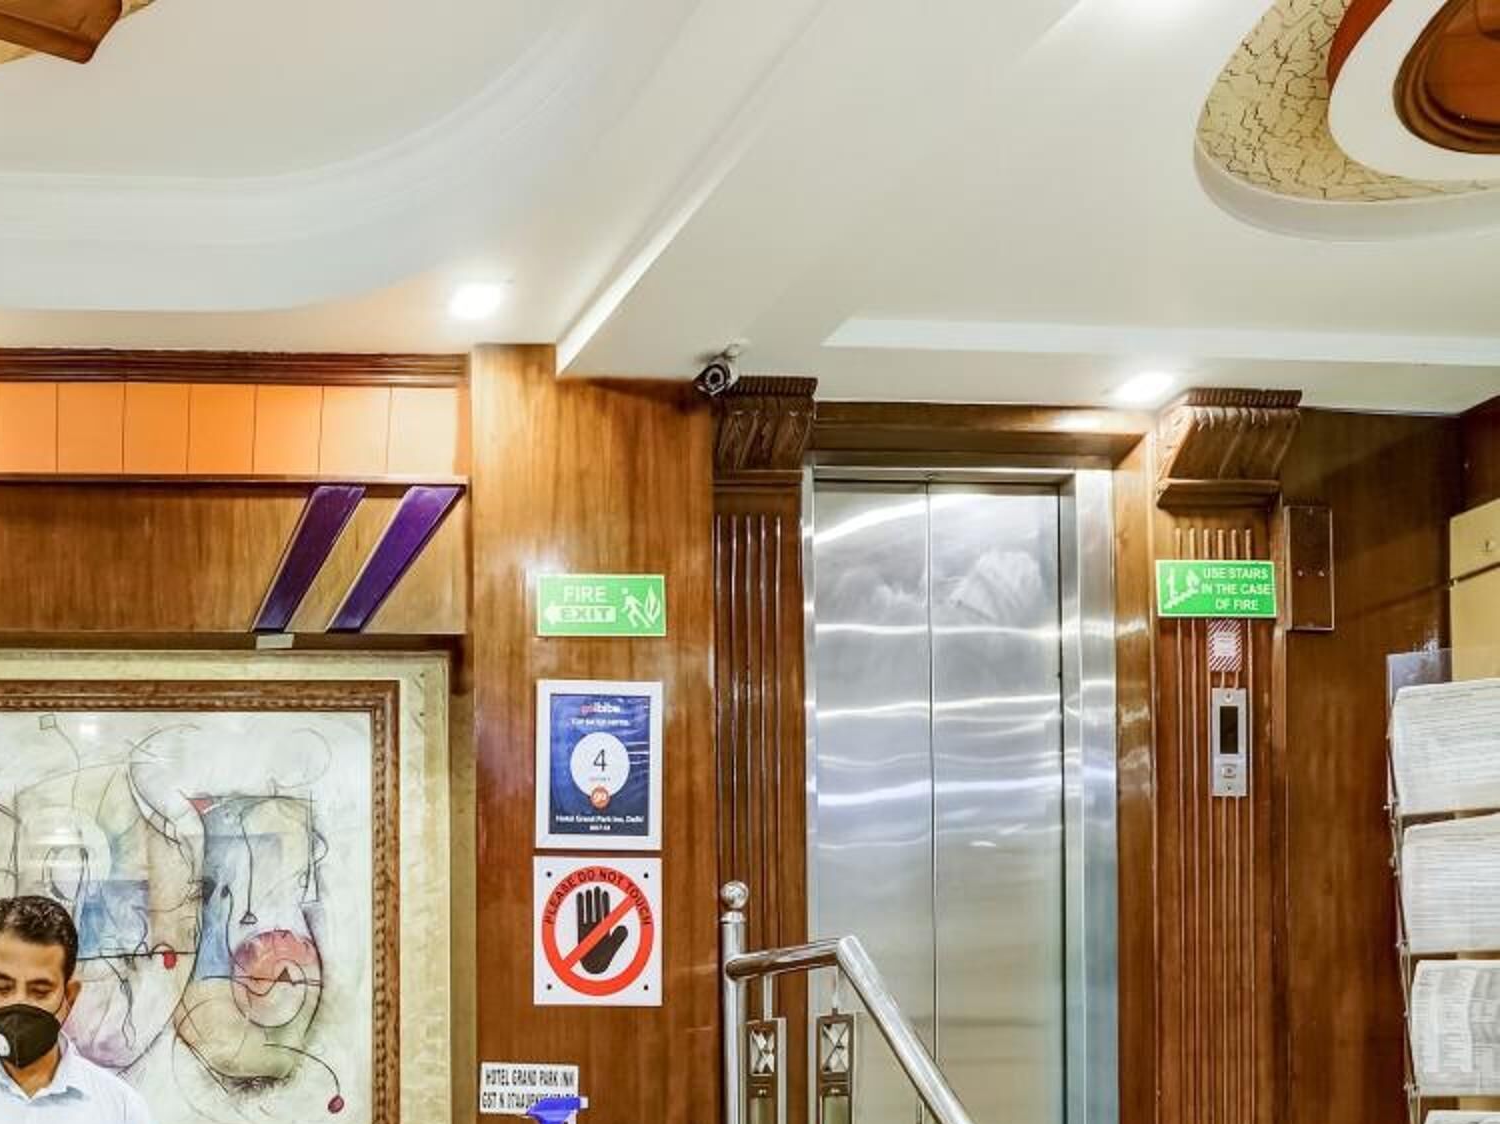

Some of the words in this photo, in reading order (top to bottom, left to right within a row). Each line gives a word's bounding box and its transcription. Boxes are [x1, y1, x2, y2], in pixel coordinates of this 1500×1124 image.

[1203, 568, 1227, 579] USE
[1228, 568, 1269, 579] STAIRS
[563, 585, 608, 603] FIRE
[1201, 583, 1213, 594] IN
[1216, 584, 1238, 595] THE
[1240, 584, 1273, 595] CASE
[1215, 598, 1231, 609] OF
[1233, 599, 1259, 610] FIRE
[562, 607, 611, 621] EXIT
[593, 748, 608, 772] 4
[543, 878, 578, 925] PLEASE
[578, 869, 596, 882] DO
[599, 869, 624, 887] NOT
[626, 881, 653, 925] TOUCH
[485, 1069, 509, 1086] HOTEL
[512, 1069, 537, 1086] GRAND
[539, 1069, 558, 1087] PARK
[483, 1092, 497, 1108] GST
